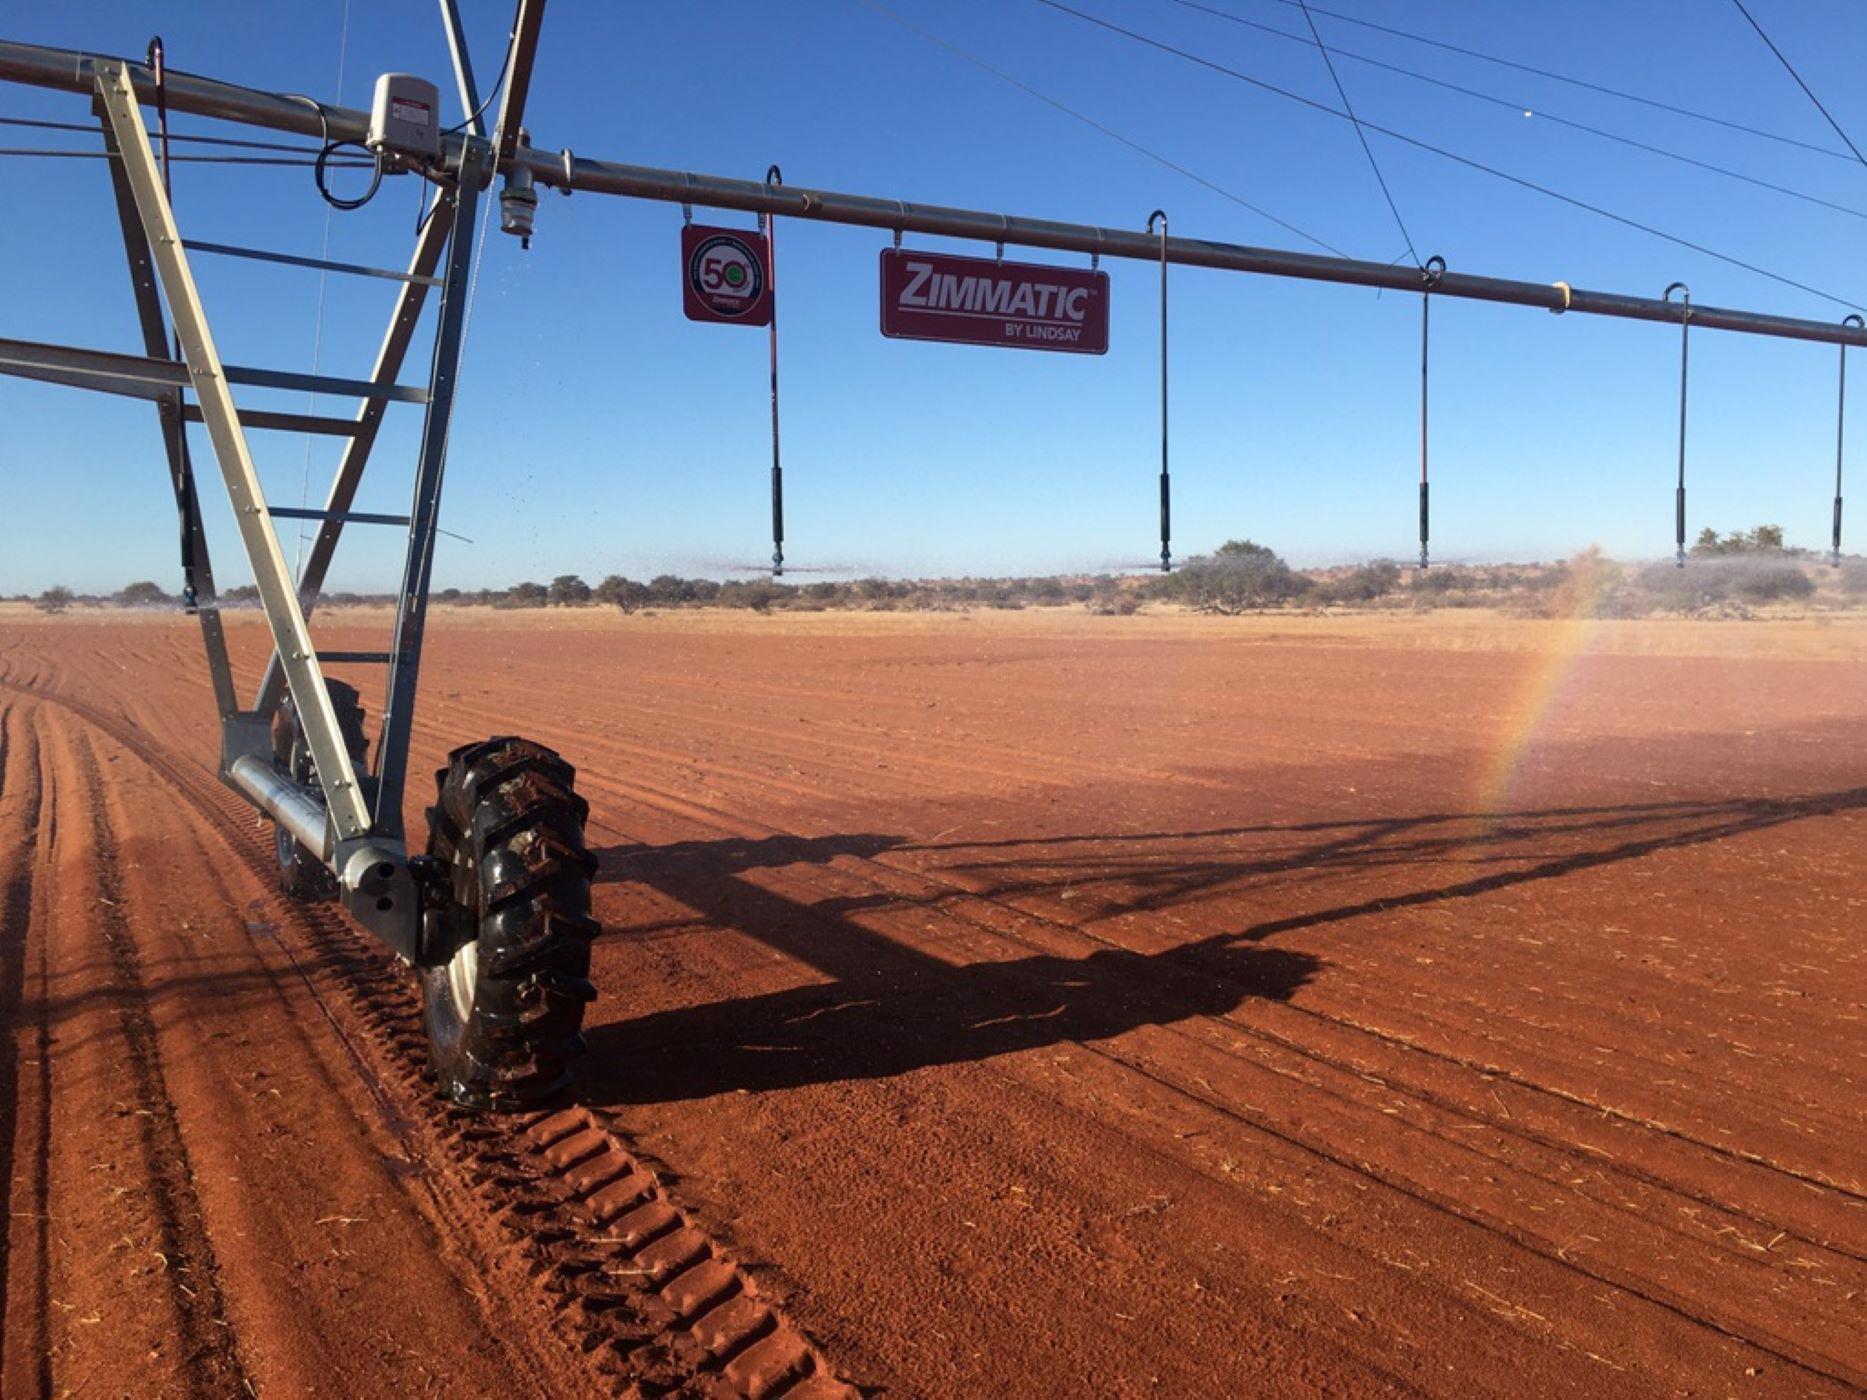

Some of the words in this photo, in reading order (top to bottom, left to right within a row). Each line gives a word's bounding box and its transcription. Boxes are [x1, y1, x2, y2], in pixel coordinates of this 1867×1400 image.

[703, 258, 748, 289] 50
[900, 261, 1088, 320] ZIMMATIC
[1005, 323, 1022, 336] BY
[1026, 326, 1082, 342] LINDSAY
